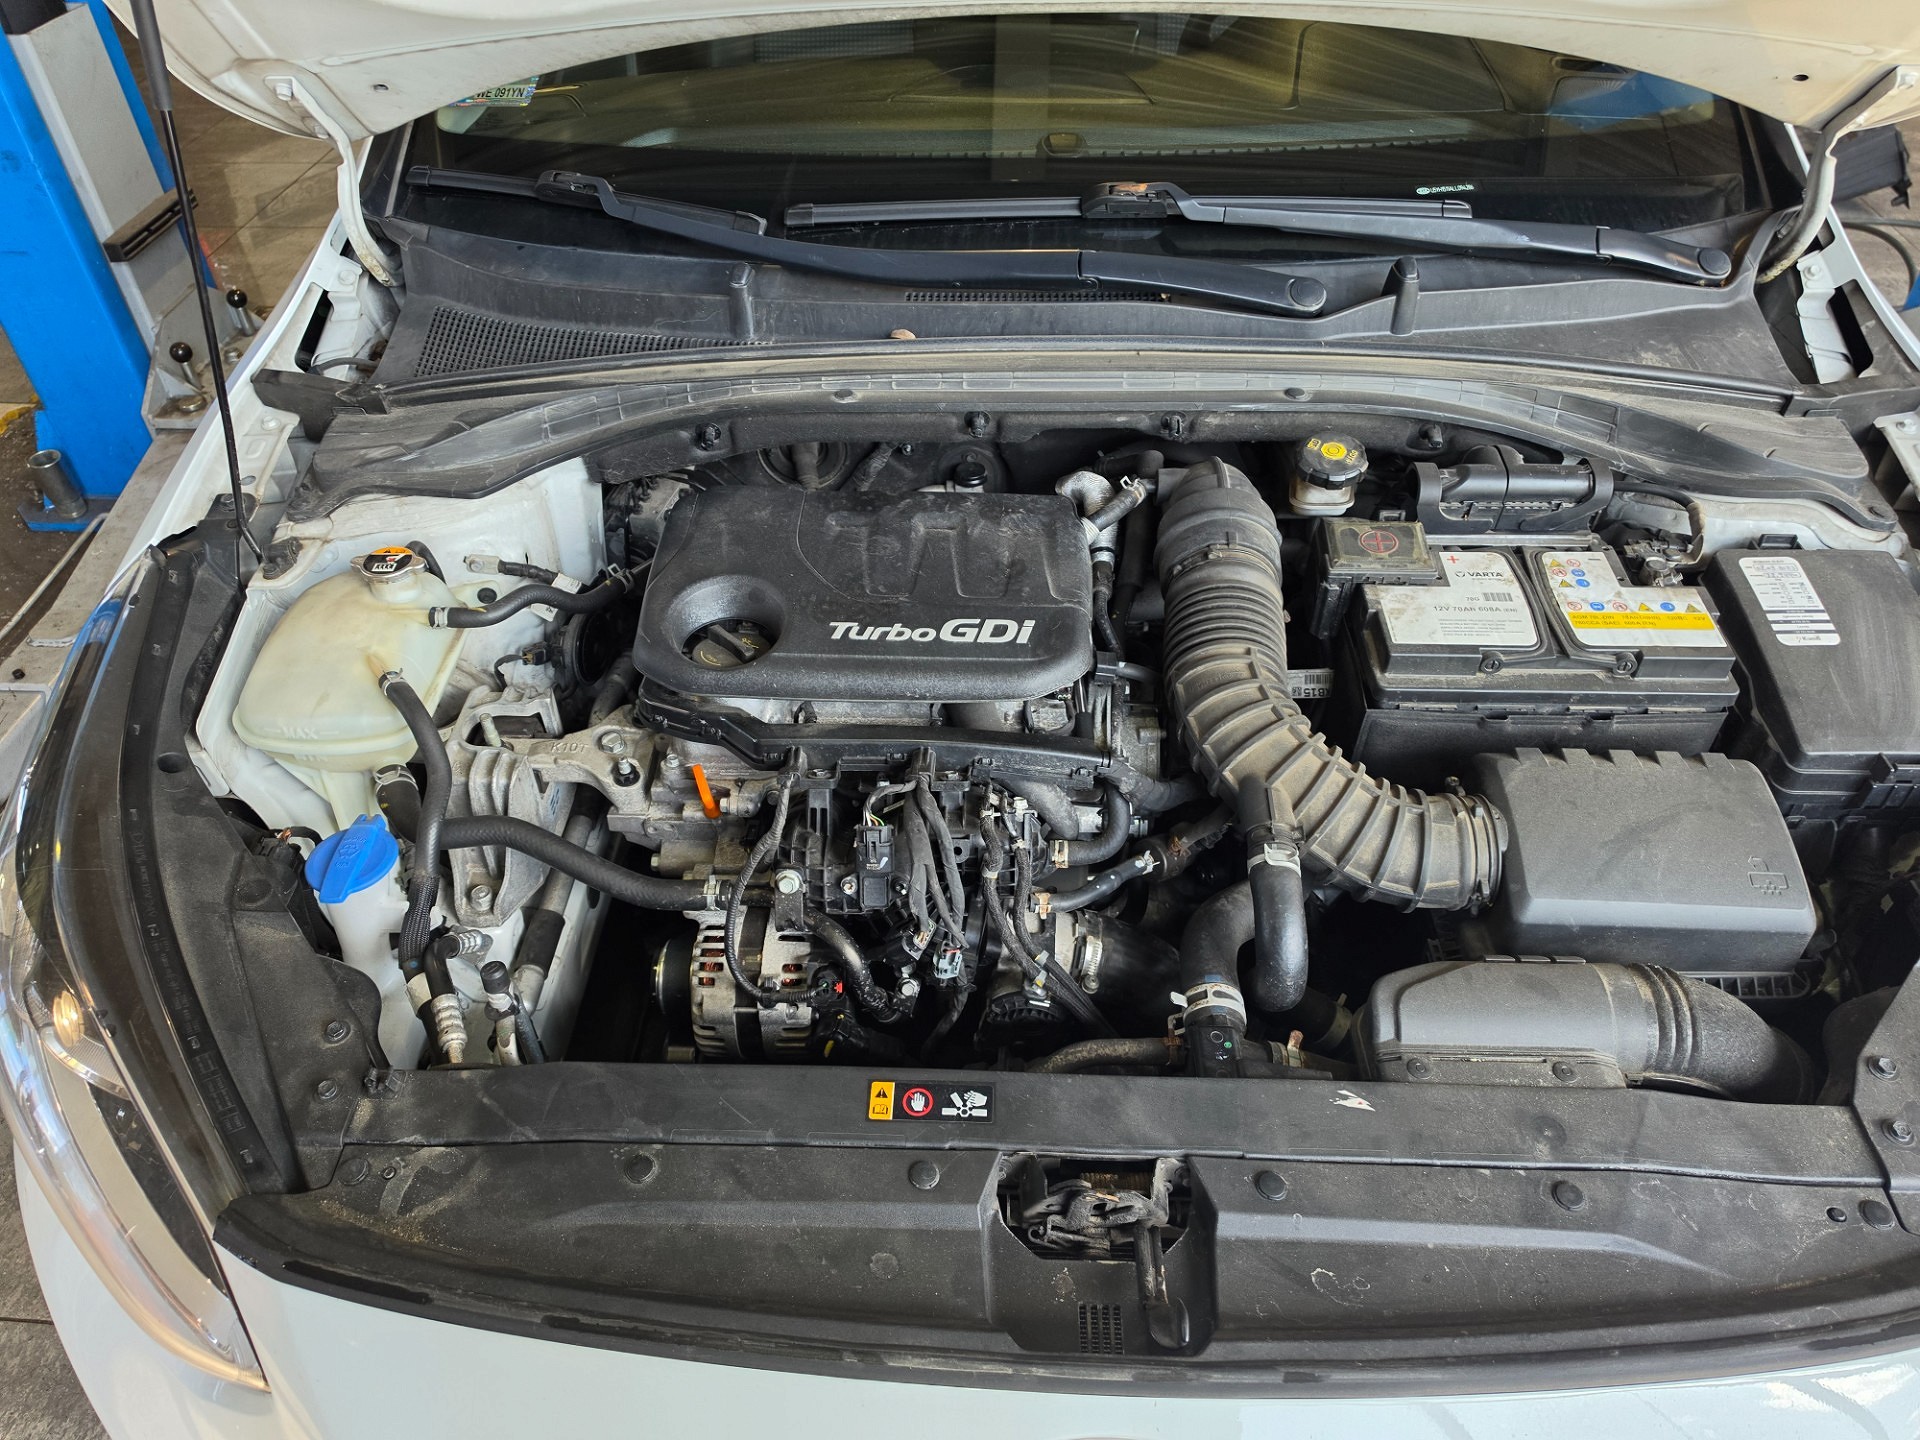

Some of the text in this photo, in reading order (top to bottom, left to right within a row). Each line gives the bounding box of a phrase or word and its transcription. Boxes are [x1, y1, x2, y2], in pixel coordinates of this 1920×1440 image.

[494, 87, 525, 98] 091YN
[939, 618, 1036, 644] GDi
[281, 725, 319, 740] MAX
